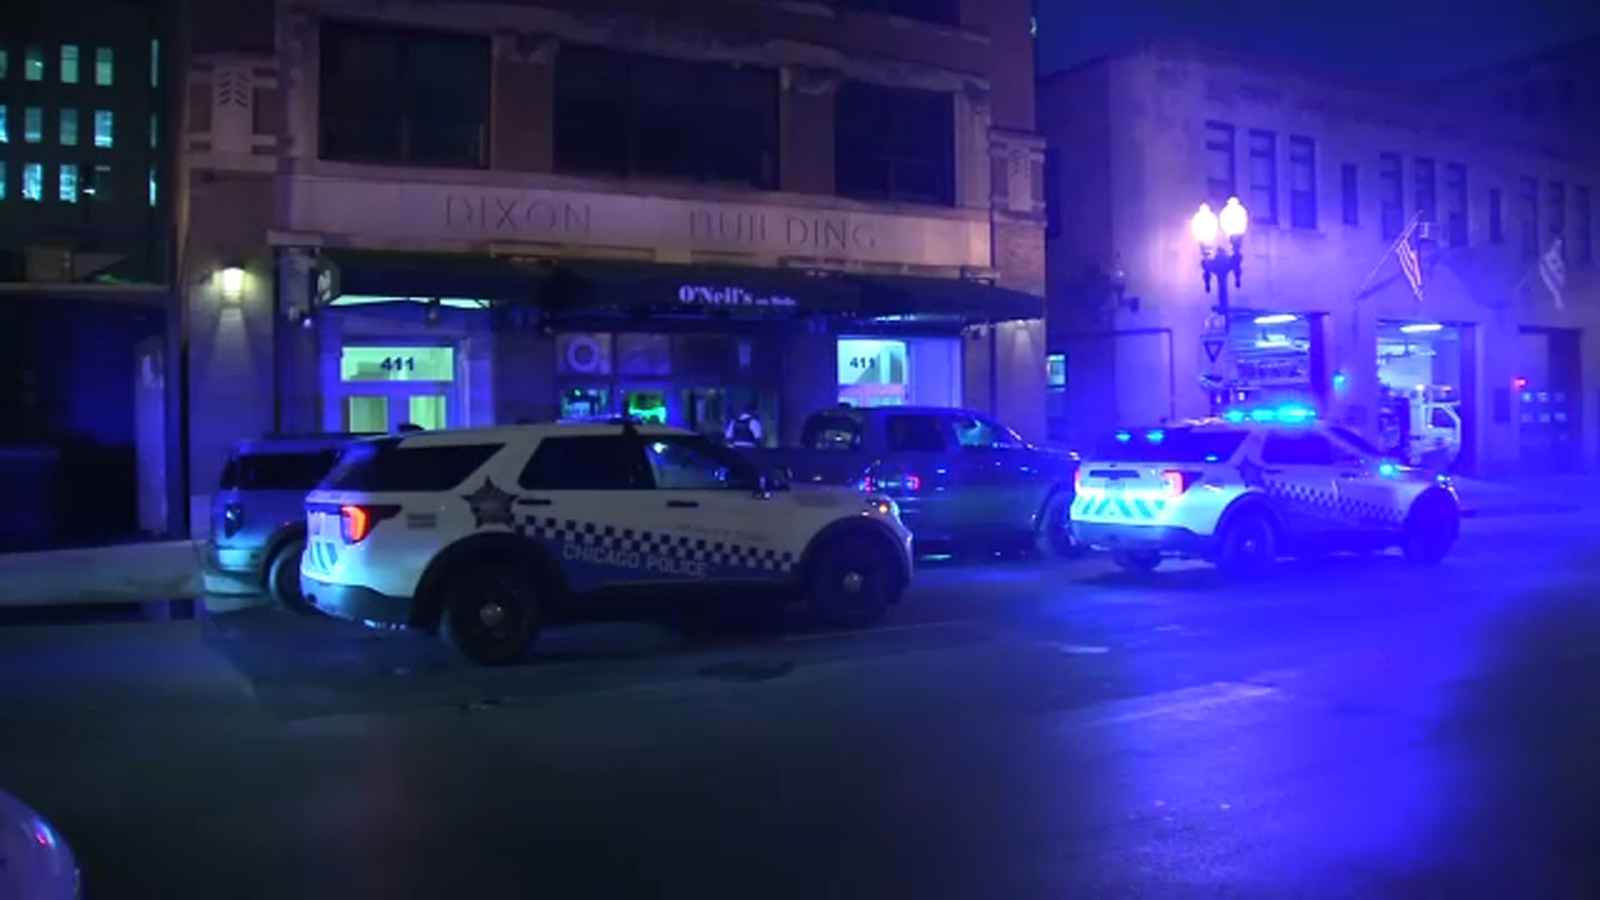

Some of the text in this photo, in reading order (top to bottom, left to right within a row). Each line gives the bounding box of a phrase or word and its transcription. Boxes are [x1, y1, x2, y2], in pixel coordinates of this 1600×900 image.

[445, 196, 875, 248] DIXON BUILDING
[380, 356, 416, 372] 411
[563, 543, 708, 579] CHICAGO POLICE
